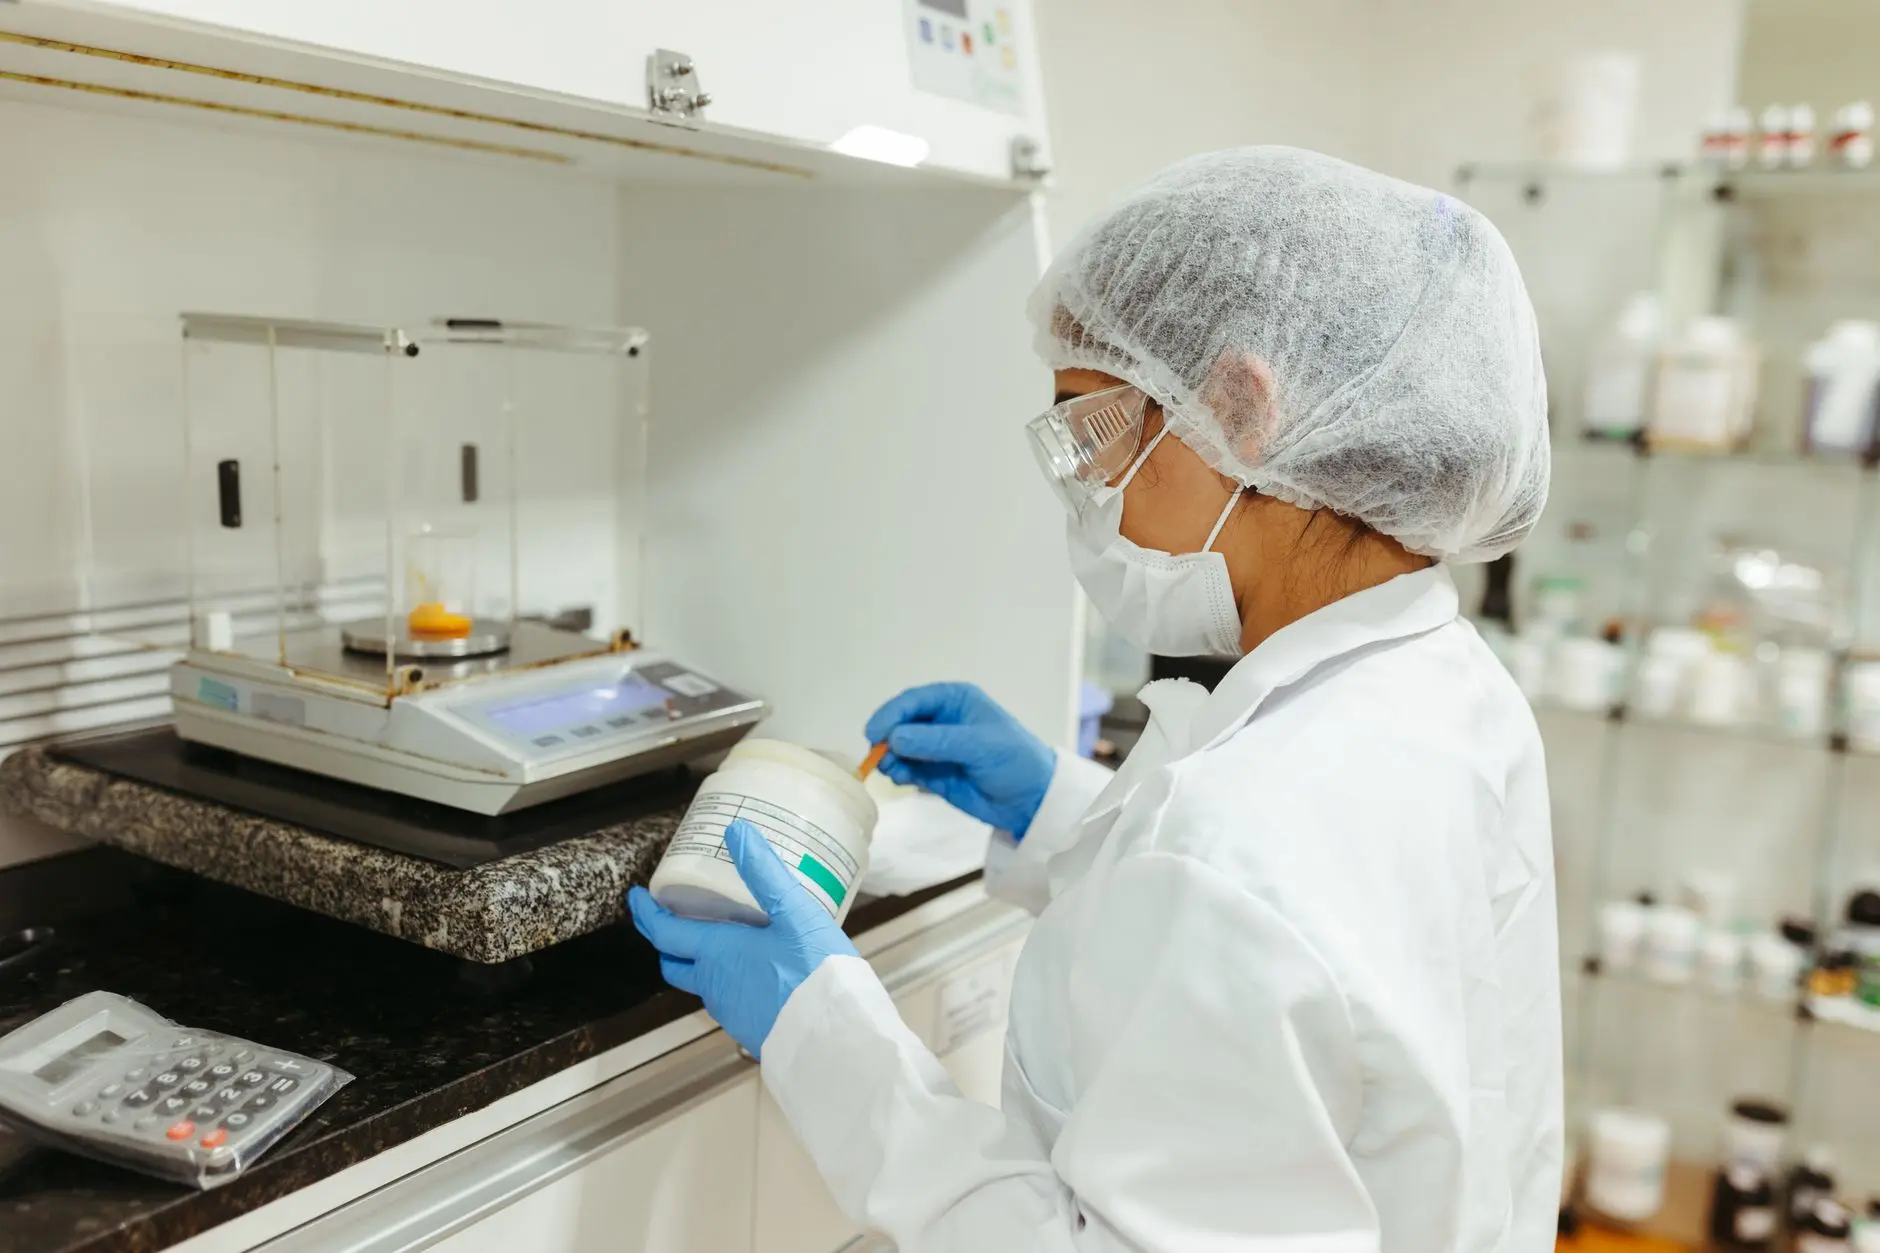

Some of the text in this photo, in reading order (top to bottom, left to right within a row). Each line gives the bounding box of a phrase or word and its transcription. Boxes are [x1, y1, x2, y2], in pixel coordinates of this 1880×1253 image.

[182, 1058, 201, 1068] 9
[212, 1064, 233, 1074] 6
[156, 1073, 178, 1083] 8
[243, 1071, 263, 1083] 3
[188, 1080, 208, 1092] 5
[130, 1089, 149, 1101] 7
[219, 1088, 242, 1100] 2
[166, 1097, 184, 1109] 4
[196, 1106, 215, 1116] 1
[227, 1113, 248, 1125] 0
